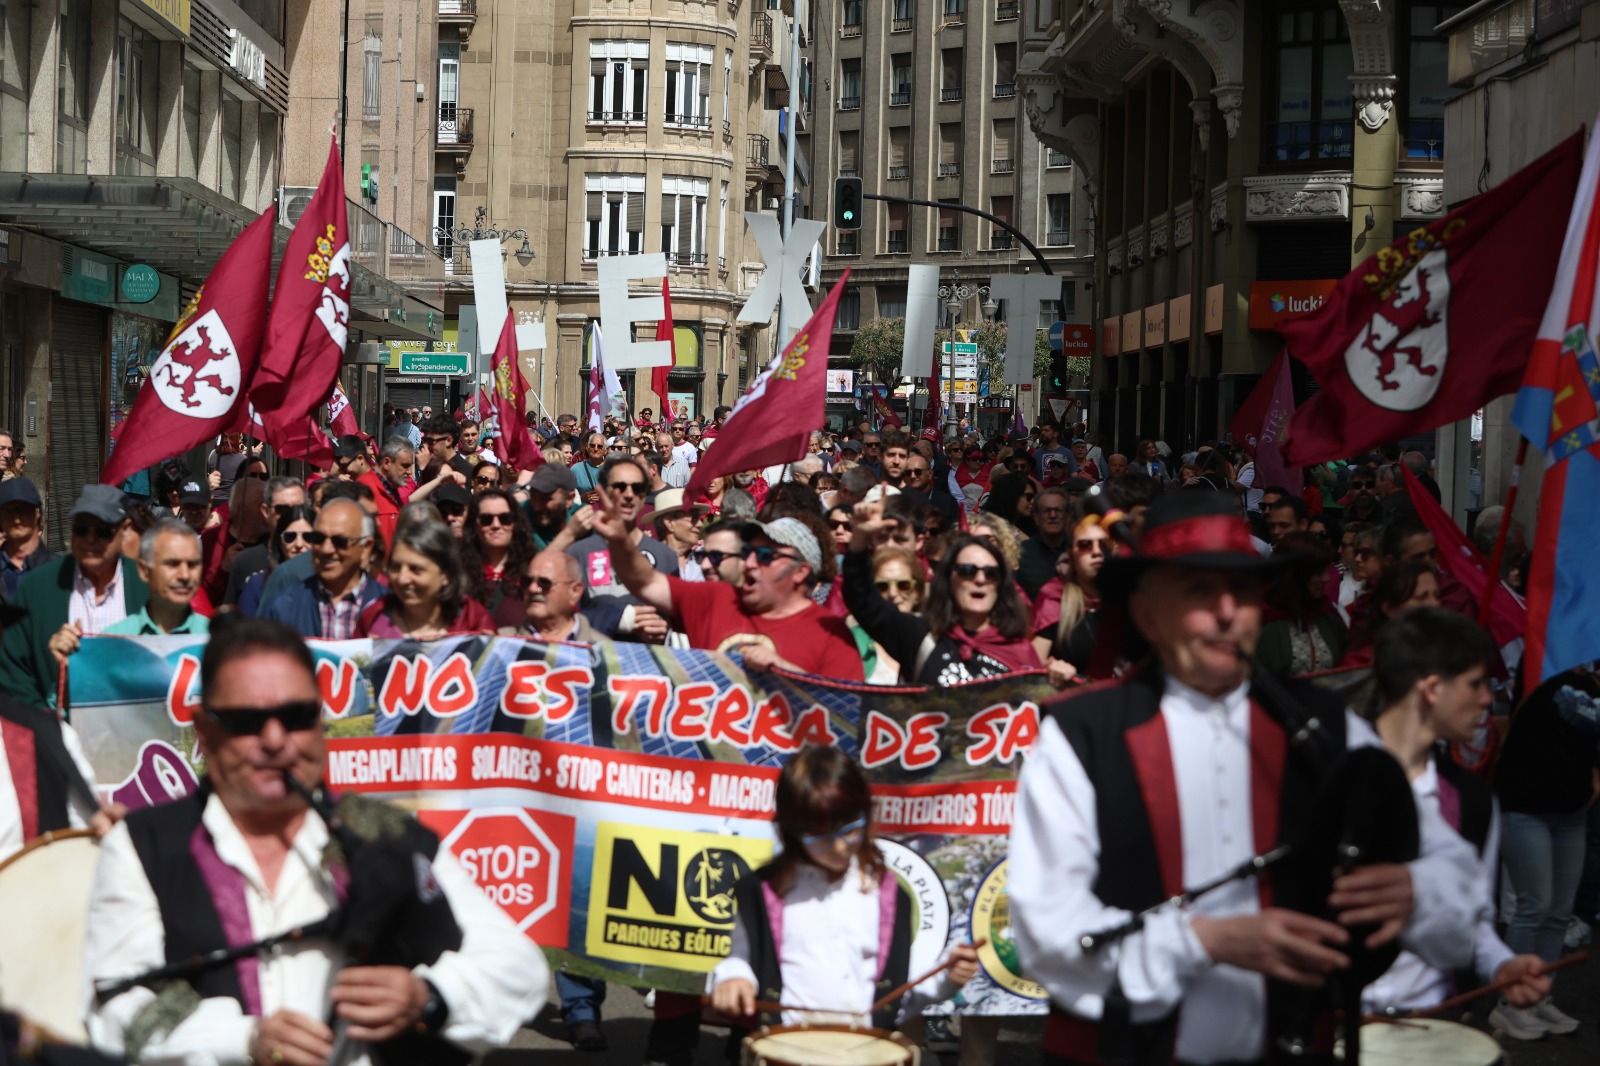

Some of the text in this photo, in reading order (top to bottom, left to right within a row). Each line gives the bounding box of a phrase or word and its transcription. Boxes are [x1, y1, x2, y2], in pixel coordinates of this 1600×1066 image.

[598, 252, 673, 371] E
[736, 212, 827, 332] X
[990, 275, 1063, 385] T
[411, 363, 458, 371] Independencia
[379, 652, 478, 718] NO
[500, 660, 594, 724] ES
[607, 675, 839, 752] TIERRA
[861, 710, 950, 770] DE
[328, 746, 457, 784] MEGAPLANTAS
[471, 745, 542, 782] SOLARES
[556, 754, 602, 792] STOP
[605, 761, 695, 805] CANTERAS
[708, 772, 777, 814] MACRO
[460, 844, 541, 881] STOP
[484, 882, 534, 906] DOS
[893, 857, 934, 931] LA PLATA
[606, 921, 680, 950] PARQUES
